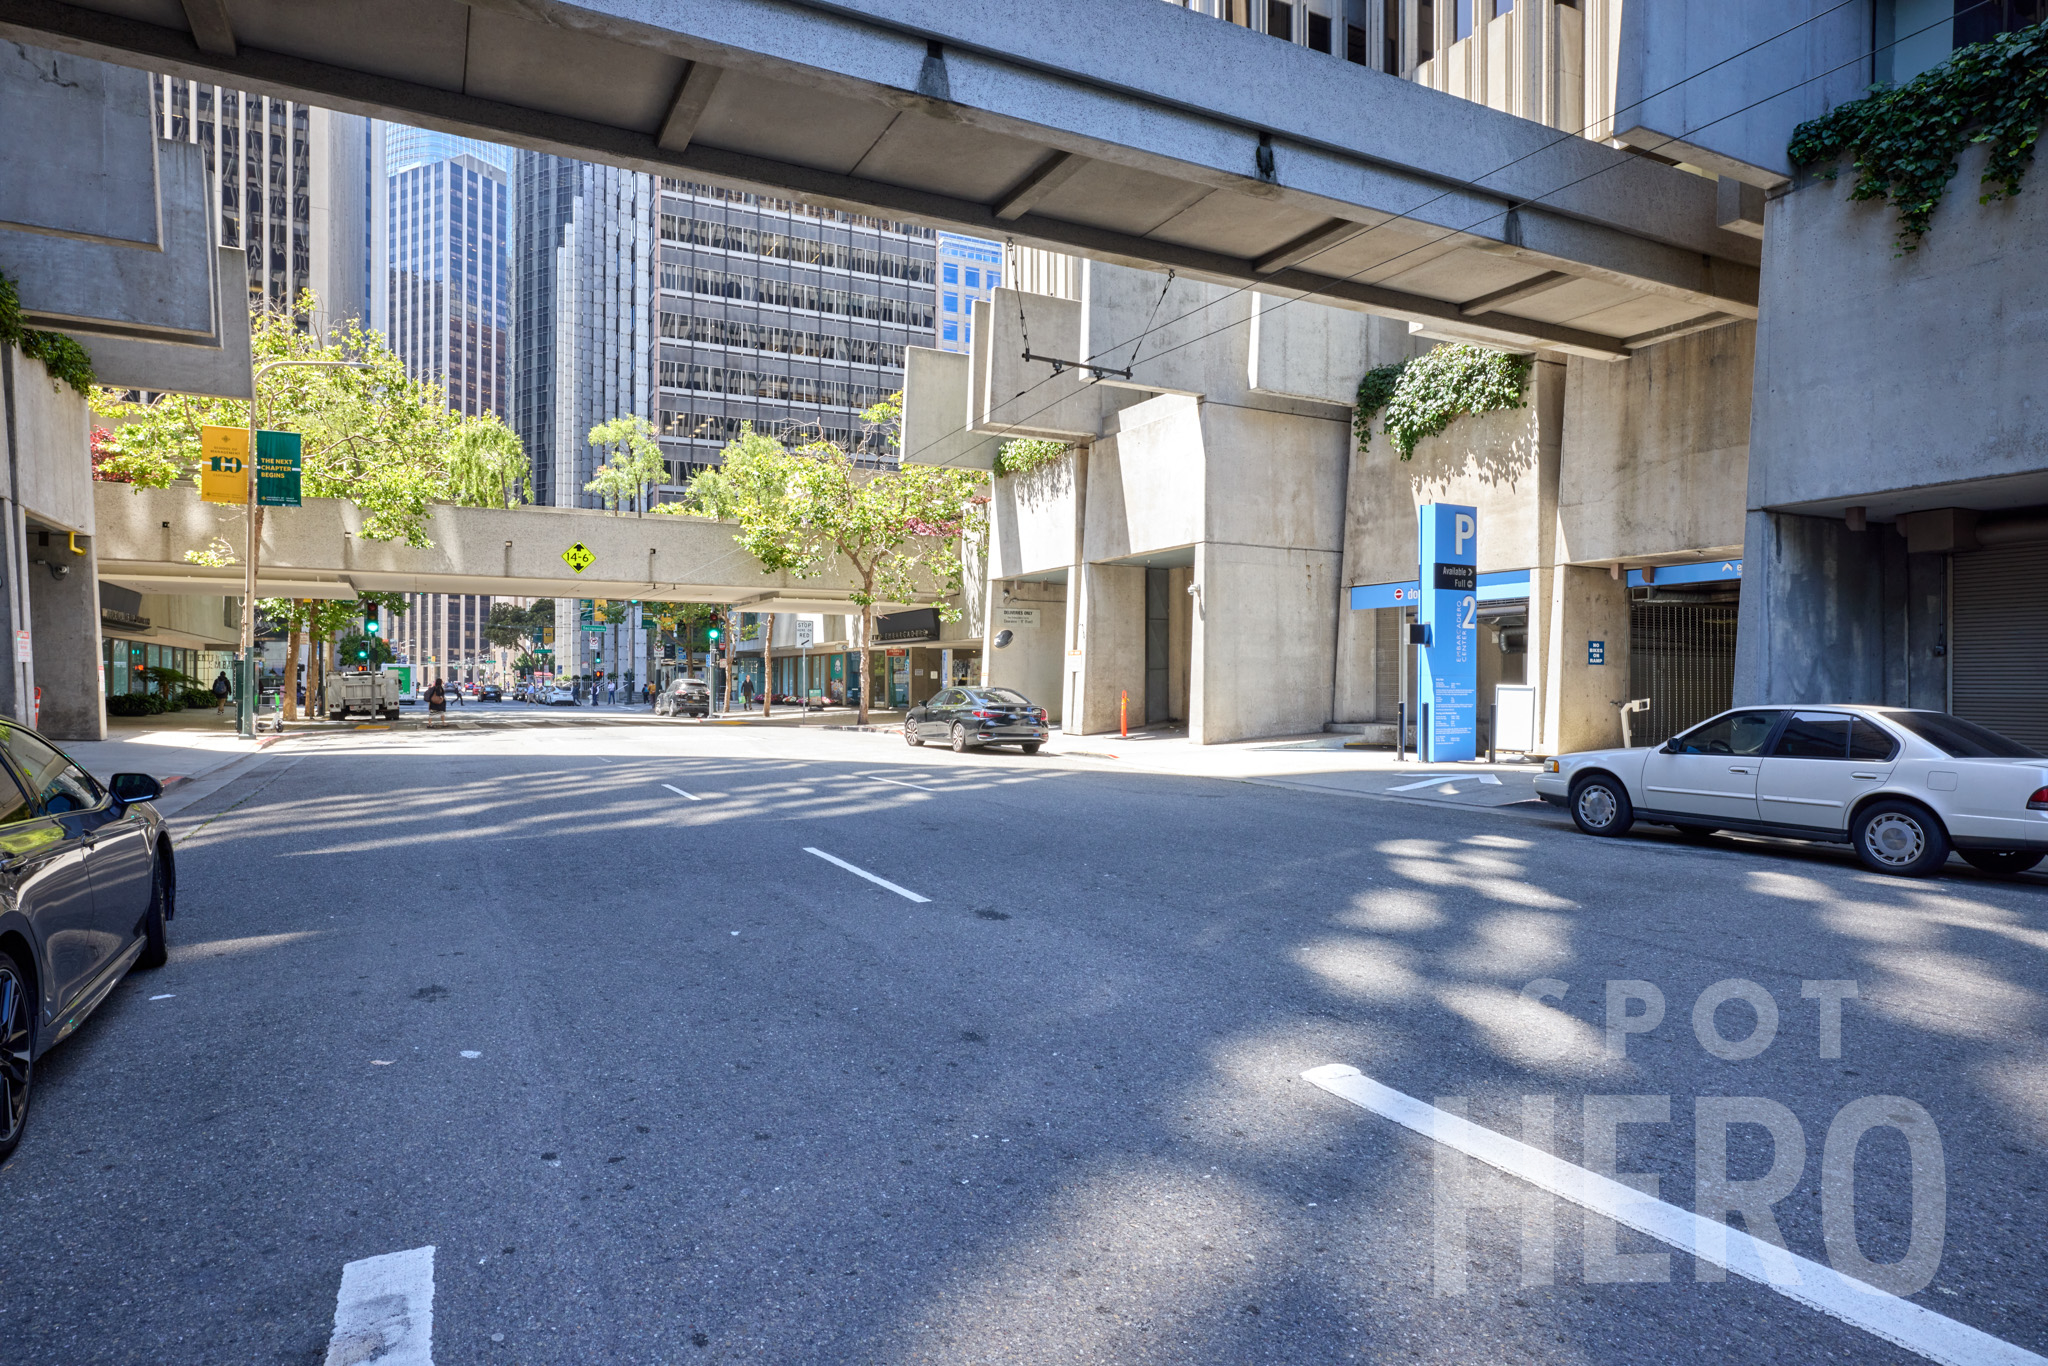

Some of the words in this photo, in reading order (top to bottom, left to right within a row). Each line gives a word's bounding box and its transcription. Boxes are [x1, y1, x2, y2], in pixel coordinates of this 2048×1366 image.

[209, 456, 242, 473] 100
[1456, 514, 1475, 555] P
[1443, 566, 1466, 576] Available
[1455, 579, 1465, 587] Full
[1462, 596, 1475, 629] 2
[884, 629, 928, 639] EMBARCADERO
